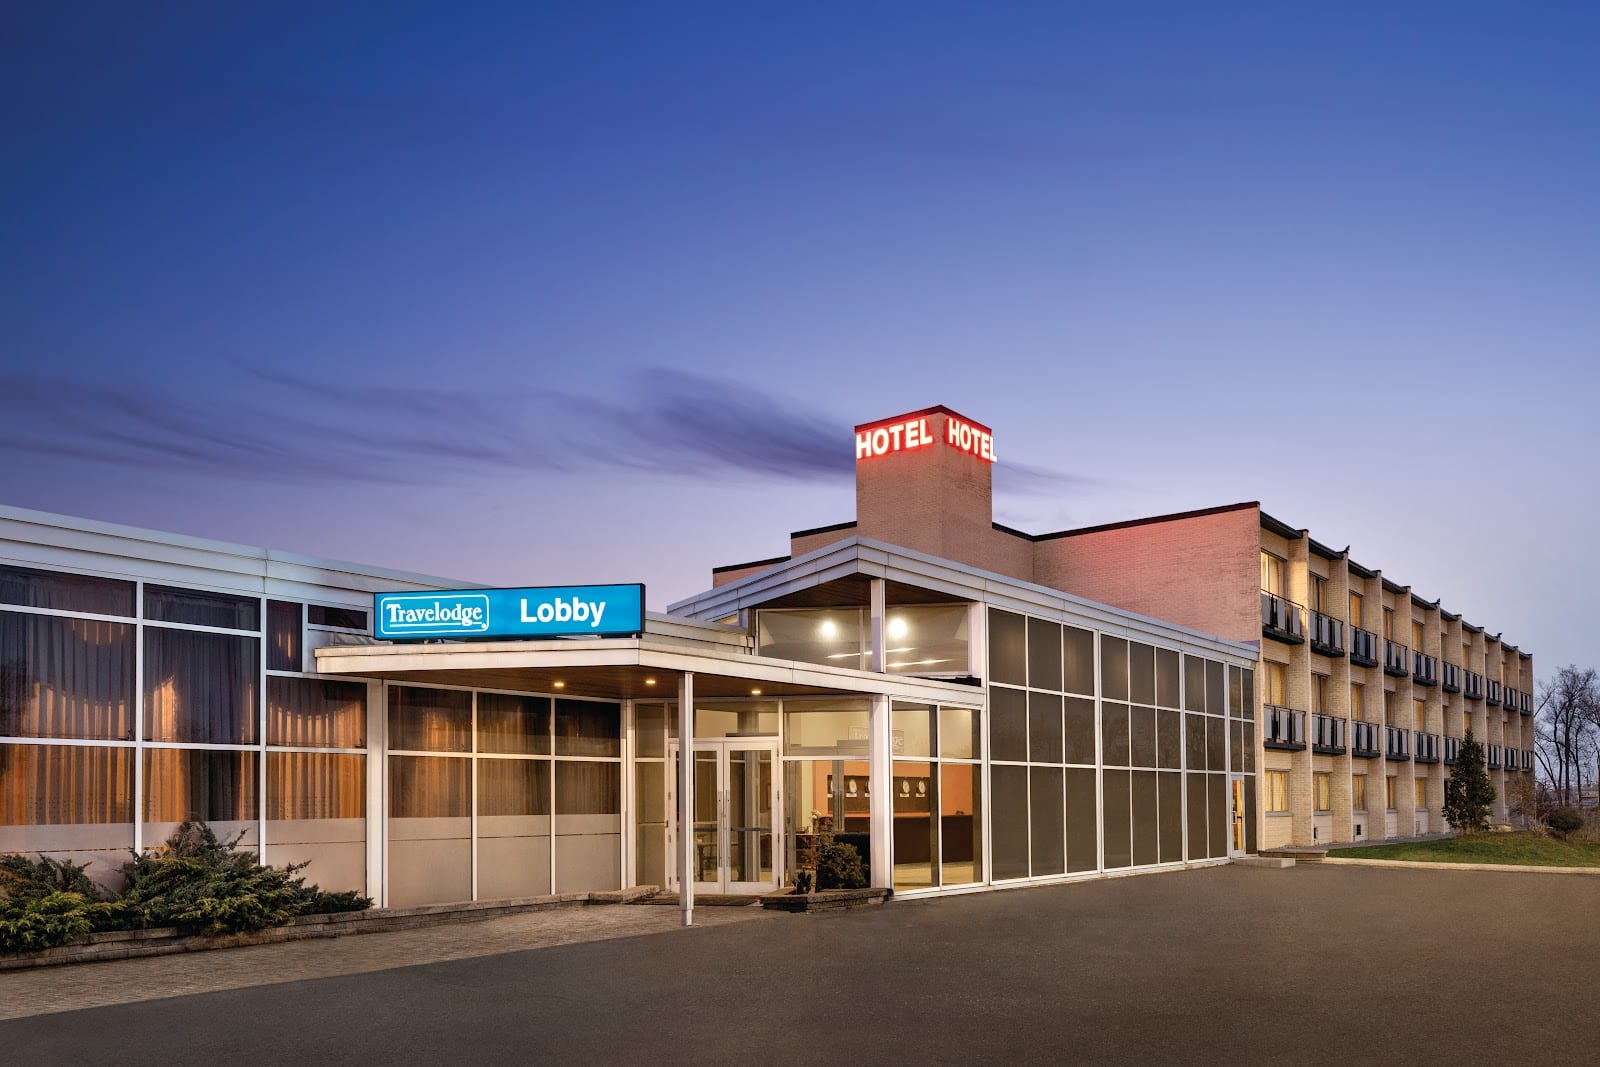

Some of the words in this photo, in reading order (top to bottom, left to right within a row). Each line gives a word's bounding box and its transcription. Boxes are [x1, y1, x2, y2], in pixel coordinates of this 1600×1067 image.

[856, 418, 933, 459] HOTEL
[948, 417, 998, 463] HOTEL
[386, 601, 483, 627] Travelodge
[520, 596, 606, 628] Lobby
